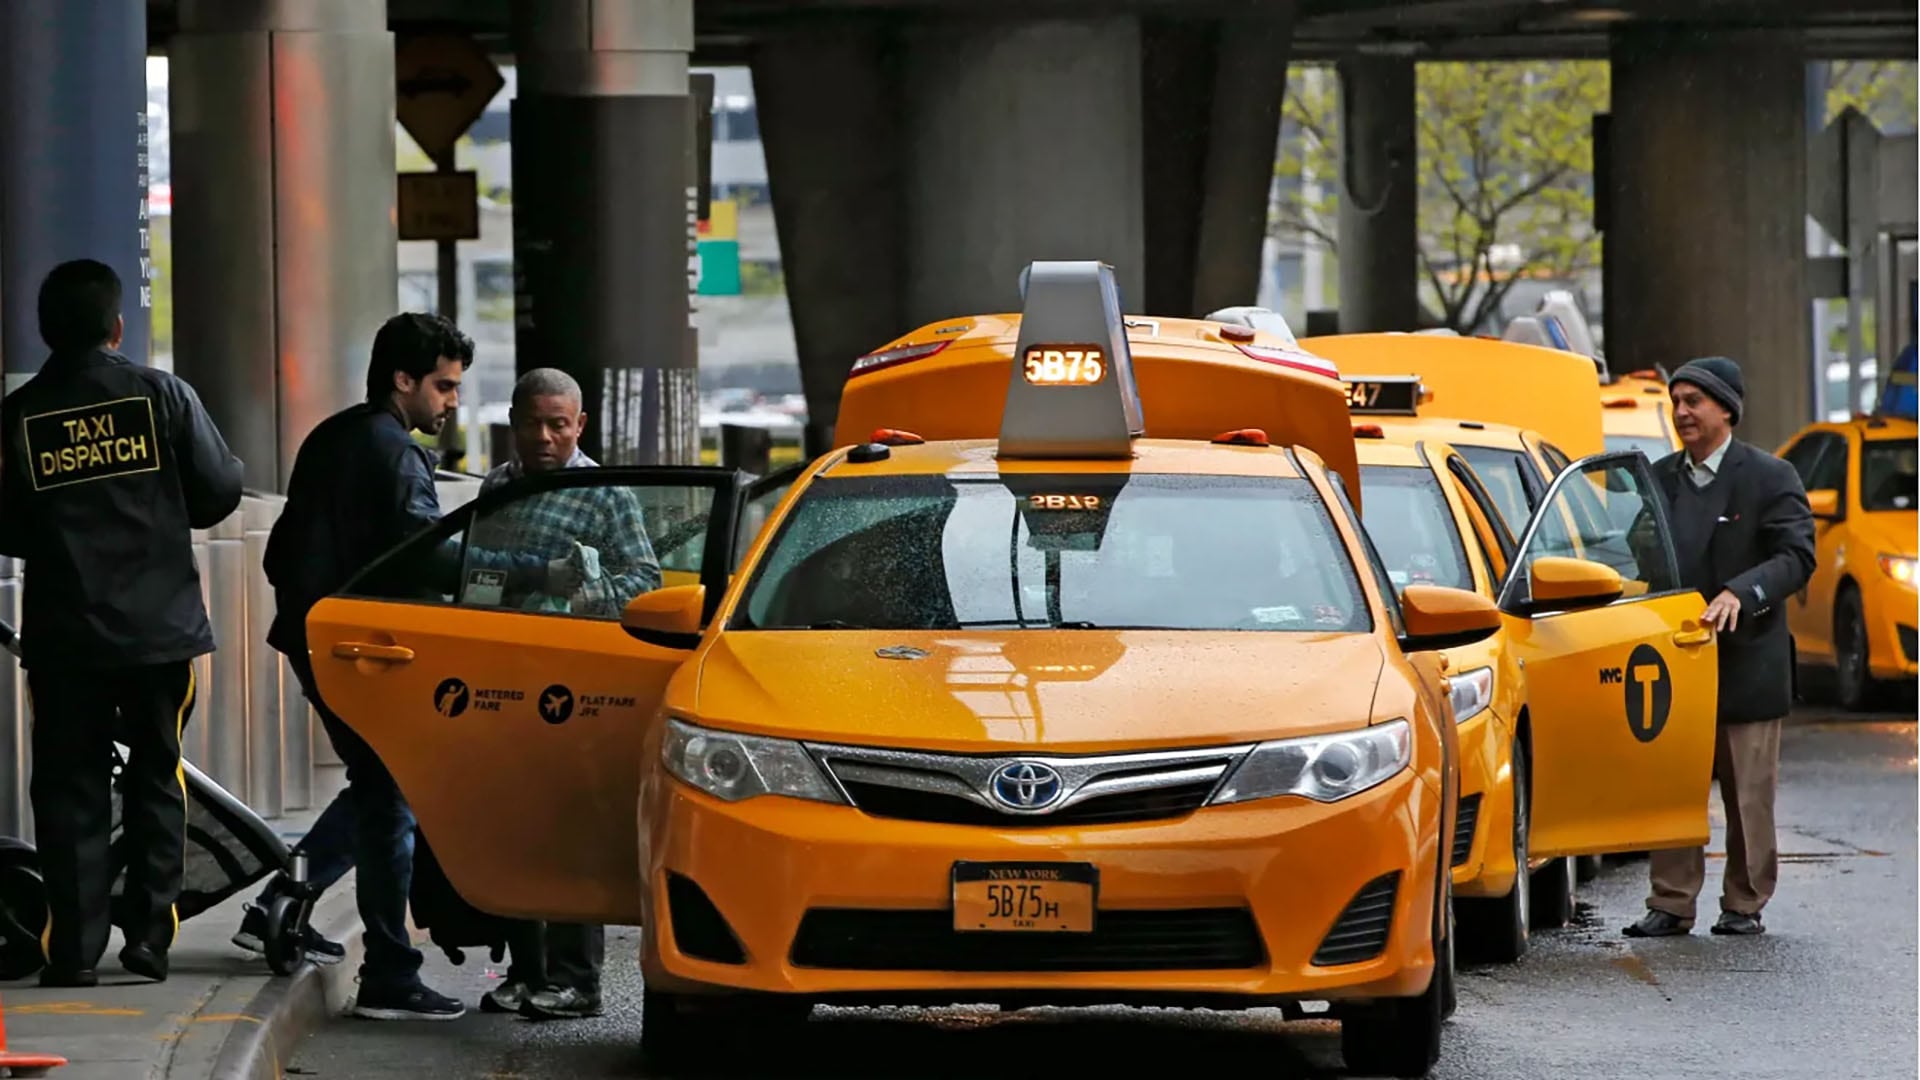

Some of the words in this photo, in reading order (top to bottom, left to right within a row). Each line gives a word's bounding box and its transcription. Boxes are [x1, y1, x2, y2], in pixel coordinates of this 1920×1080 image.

[1025, 351, 1102, 382] 5B75
[63, 413, 115, 443] TAXI
[40, 435, 147, 476] DISPATCH
[475, 689, 524, 701] METERED
[580, 695, 605, 706] FLAT
[608, 697, 635, 707] FARE
[1600, 667, 1622, 684] NYC
[1634, 664, 1660, 729] T
[474, 701, 501, 711] FARE
[579, 708, 599, 717] JFK
[989, 869, 1021, 879] NEW
[1025, 869, 1059, 879] YORK
